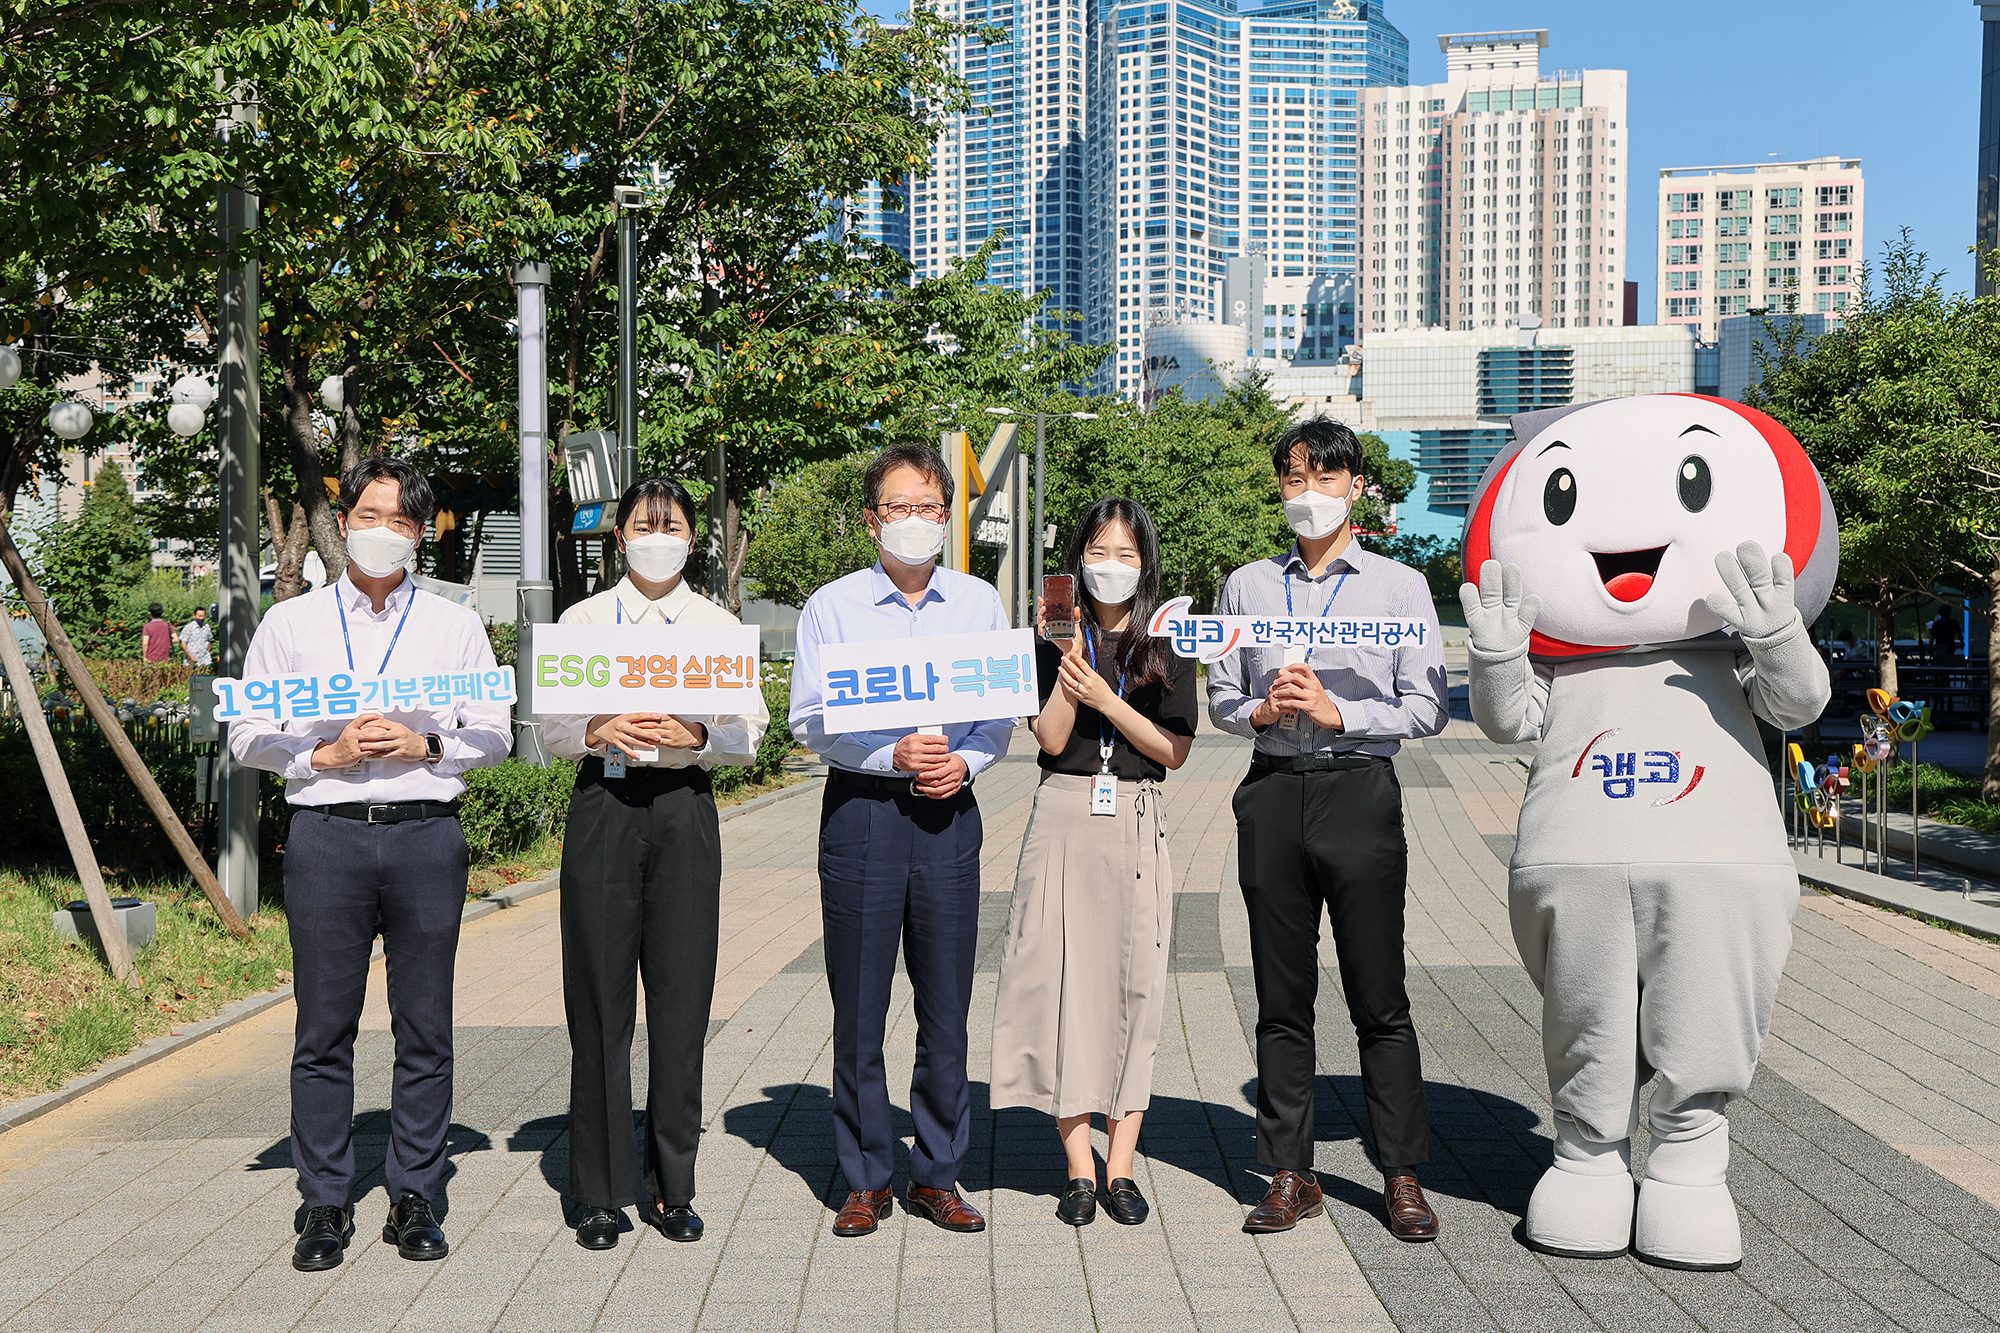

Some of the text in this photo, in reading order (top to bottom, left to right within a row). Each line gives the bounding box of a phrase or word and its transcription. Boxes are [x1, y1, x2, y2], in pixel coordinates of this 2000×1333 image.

[1168, 619, 1427, 653] 캠코 한국자산관리공사
[536, 654, 755, 690] ESG 경영 실천!
[826, 653, 1033, 708] 코로나 극복!
[1591, 750, 1680, 799] 캠코
